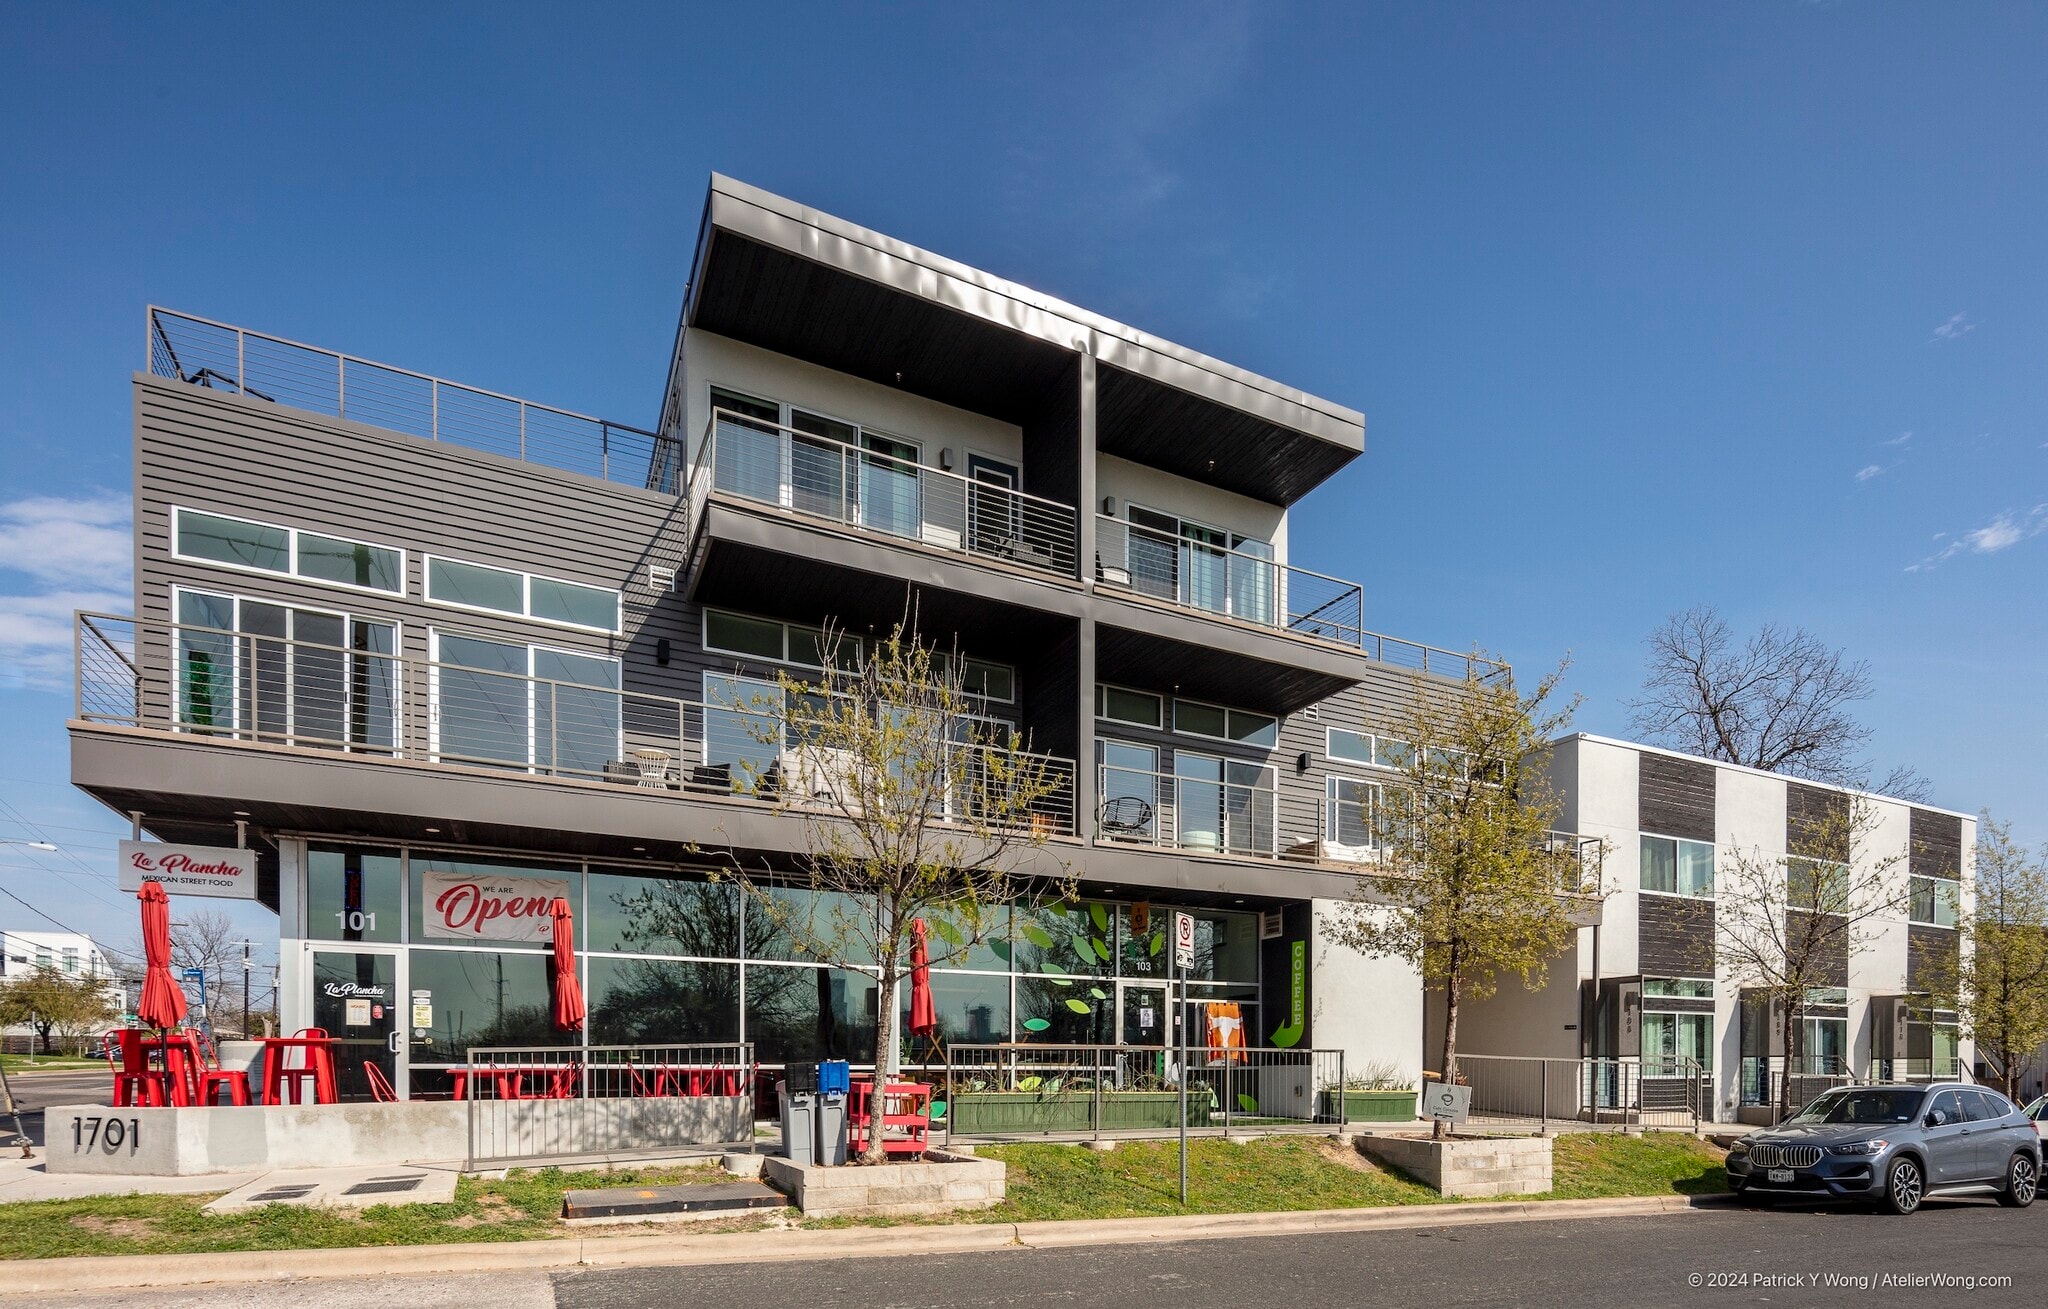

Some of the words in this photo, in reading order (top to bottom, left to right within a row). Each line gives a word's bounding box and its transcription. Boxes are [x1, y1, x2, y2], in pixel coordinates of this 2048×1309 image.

[131, 852, 157, 871] La
[159, 854, 243, 877] Plancha
[141, 875, 178, 883] MEXICAN
[180, 877, 207, 885] STREET
[208, 879, 234, 887] FOOD
[435, 883, 552, 934] Open
[335, 911, 376, 931] 101
[1136, 961, 1151, 971] 103
[324, 982, 345, 998] La
[340, 982, 386, 996] Plancha
[1294, 945, 1302, 1025] COFFEE
[73, 1116, 140, 1149] 1701
